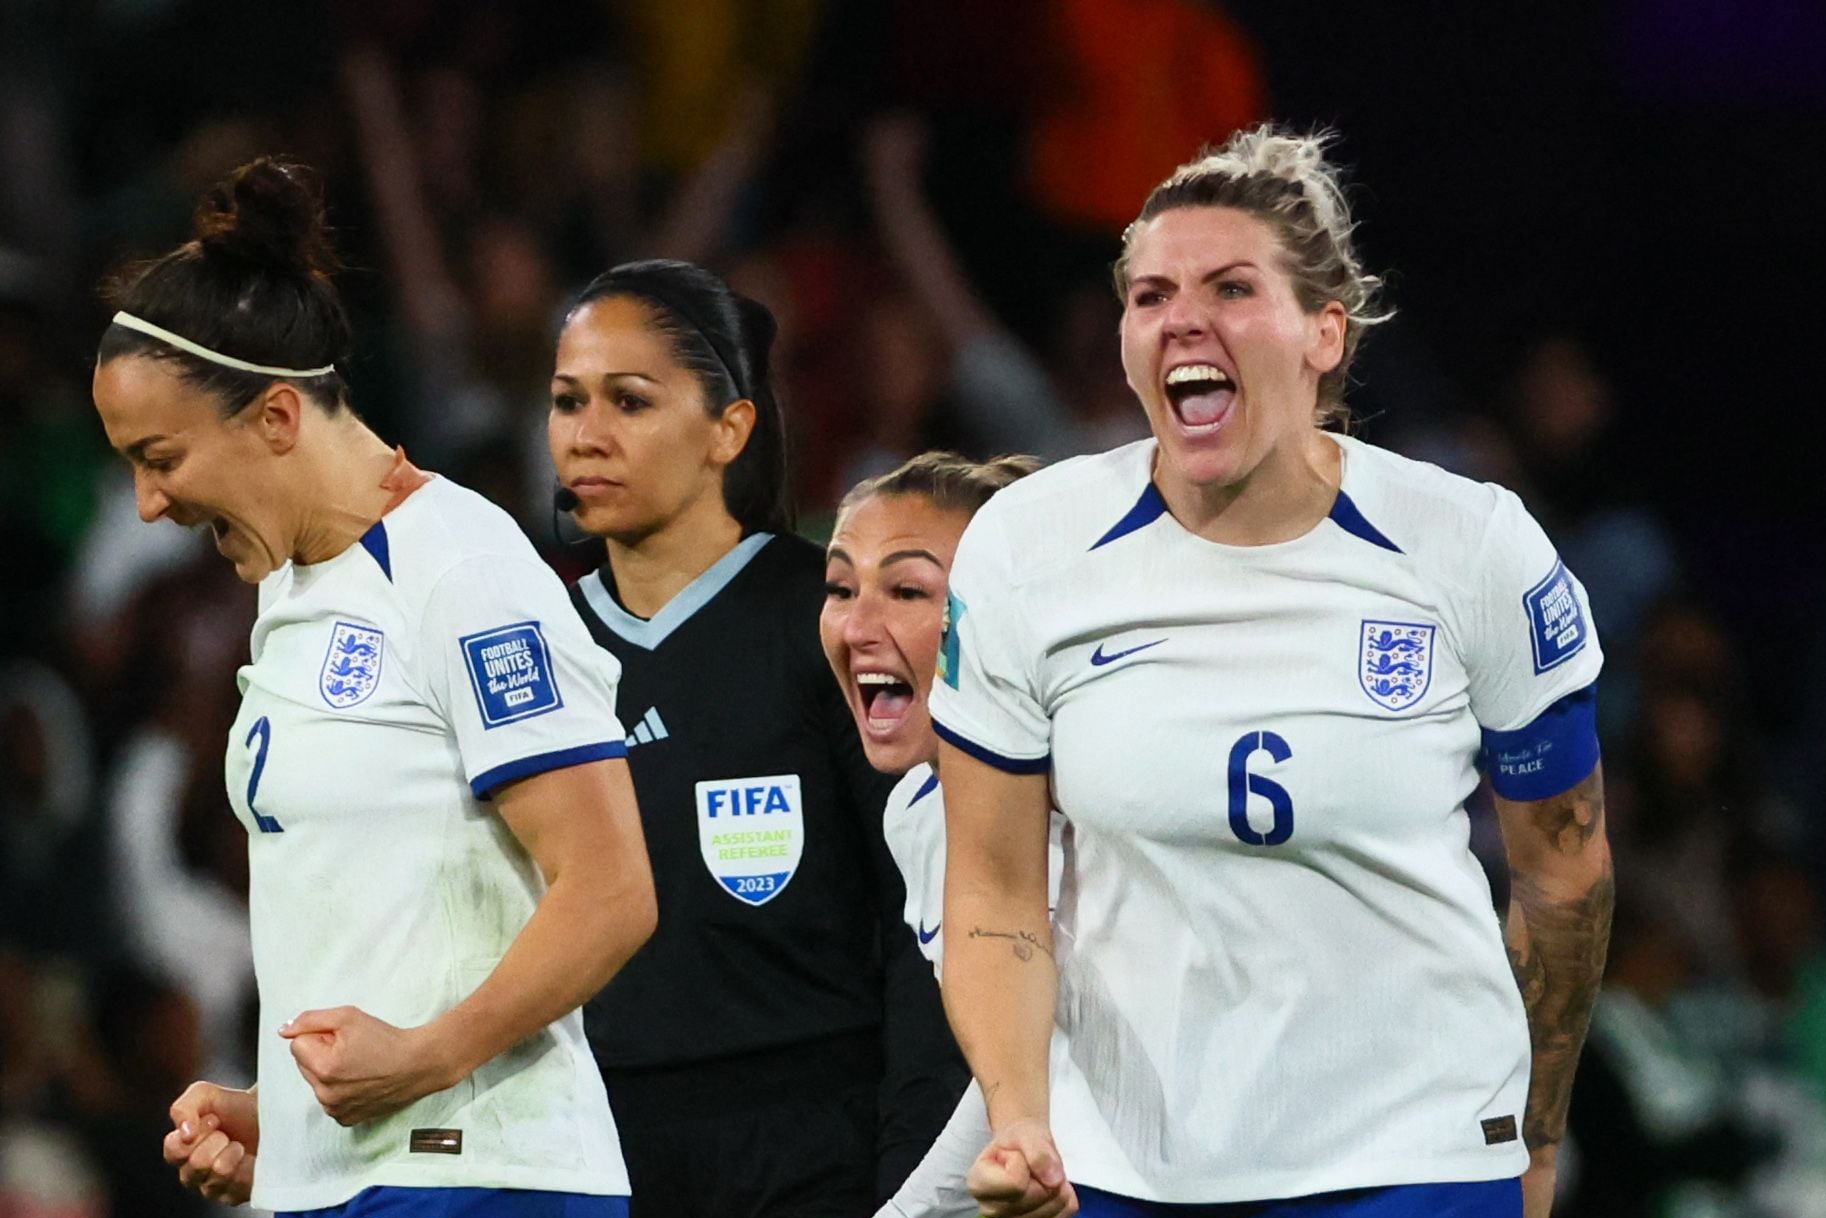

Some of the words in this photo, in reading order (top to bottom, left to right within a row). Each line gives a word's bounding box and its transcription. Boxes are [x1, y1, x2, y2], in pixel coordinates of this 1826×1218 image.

[481, 638, 531, 660] FOOTBALL
[484, 650, 534, 677] UNITES
[487, 678, 507, 695] the
[506, 666, 540, 689] World
[508, 691, 530, 702] FIFA
[245, 716, 284, 833] 2
[1500, 759, 1544, 775] PEACE
[1227, 731, 1294, 846] 6
[707, 786, 791, 818] FIFA
[712, 829, 793, 846] ASSISTANT
[719, 844, 789, 860] REFEREE
[736, 877, 775, 893] 2023
